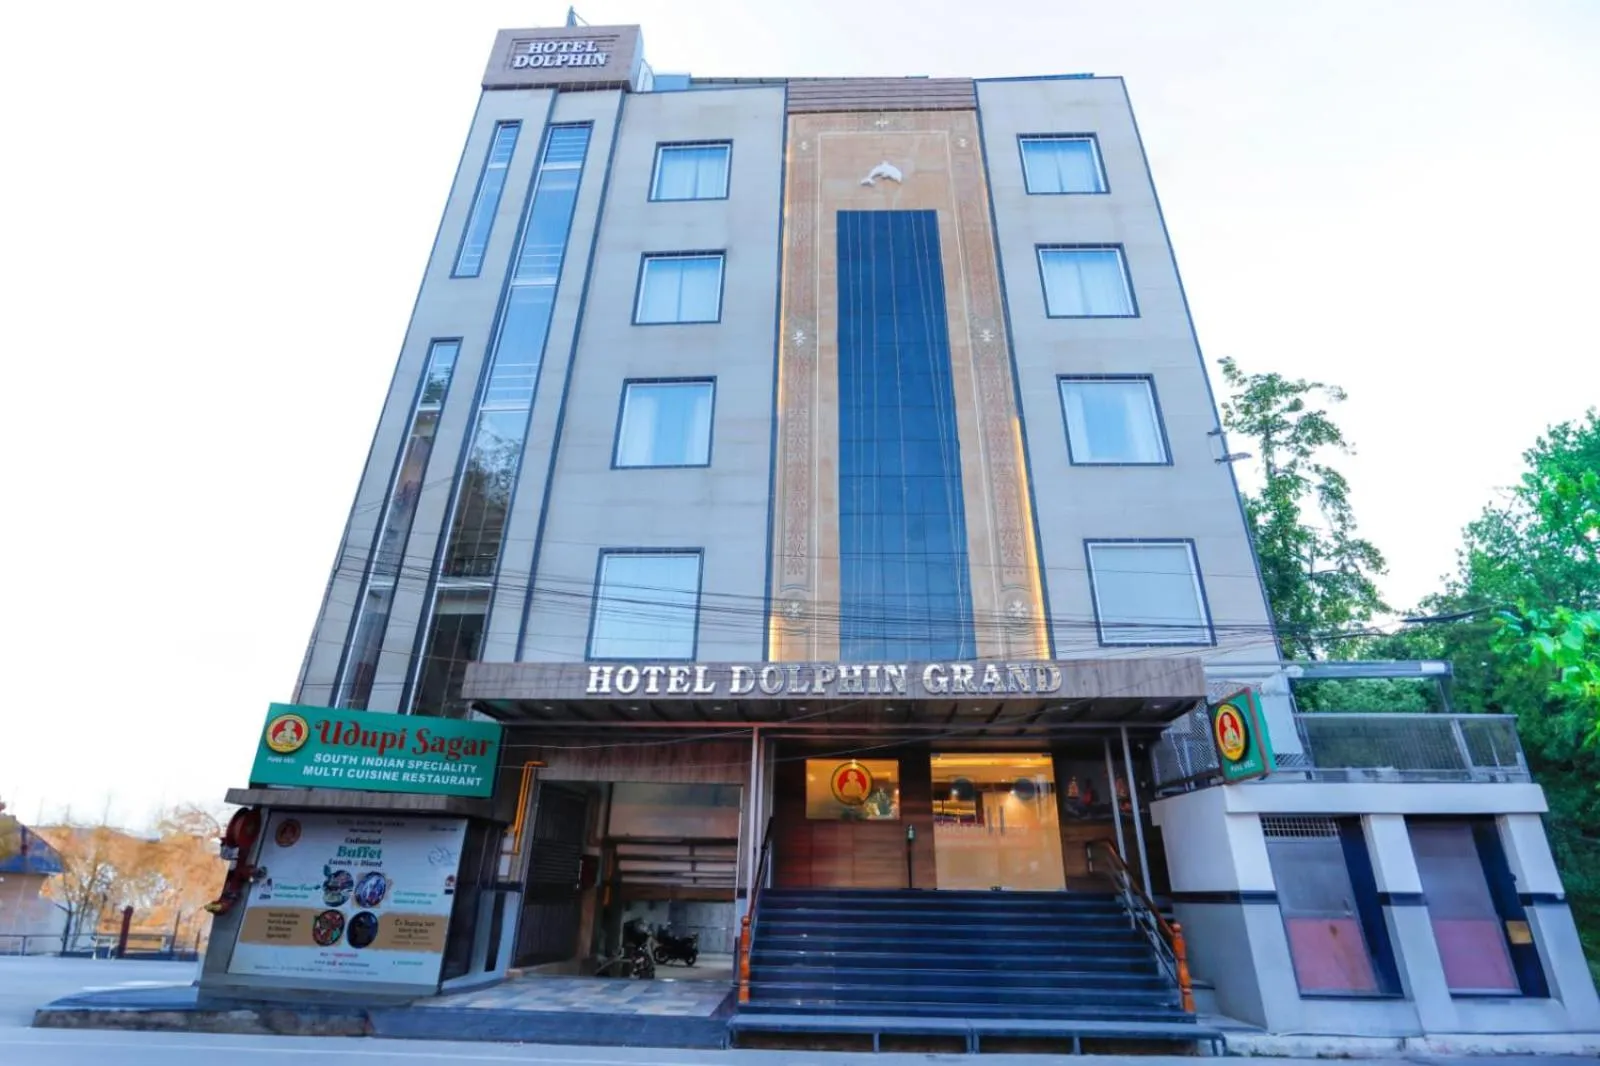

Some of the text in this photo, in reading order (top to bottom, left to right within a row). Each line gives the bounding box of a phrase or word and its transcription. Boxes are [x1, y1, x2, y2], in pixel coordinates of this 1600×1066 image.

[528, 41, 597, 53] HOTEL
[513, 52, 607, 68] DOLPHIN
[586, 663, 1063, 695] HOTEL DOLPHIN GRAND
[315, 719, 494, 760] Udupi Sagar
[313, 752, 478, 773] SOUTH INDIAN SPECIALITY
[302, 765, 483, 787] MULTI CUISINE RESTAURANT
[336, 846, 382, 859] Buffet
